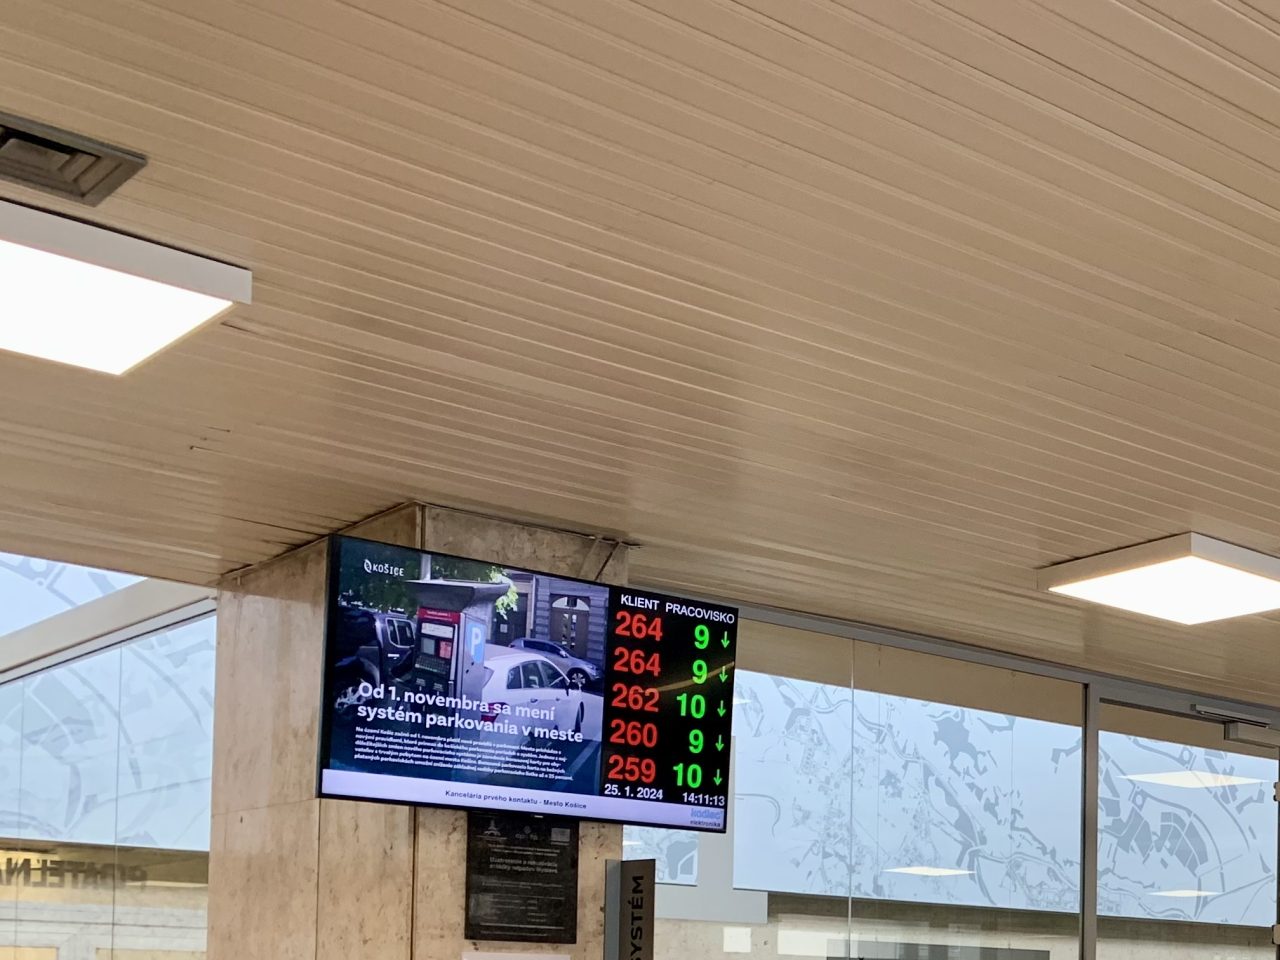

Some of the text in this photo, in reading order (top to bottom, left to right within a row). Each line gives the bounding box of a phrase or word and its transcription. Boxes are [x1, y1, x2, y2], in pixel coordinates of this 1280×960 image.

[372, 563, 404, 577] KOŠICE
[620, 594, 735, 624] KLIENT PRACOVISKO
[615, 610, 710, 649] 264 9
[613, 646, 708, 684] 264 9
[358, 682, 555, 721] Od 1. novembra sa mení
[611, 683, 706, 719] 262 10
[357, 703, 584, 743] systém parkovania v meste
[609, 719, 704, 754] 260 9
[607, 754, 702, 788] 259 10
[445, 790, 482, 800] Kancelária
[483, 794, 507, 803] prvého
[508, 797, 538, 805] kontaktu
[543, 799, 564, 807] Mesto
[564, 801, 587, 809] Košice
[604, 783, 725, 806] 25. 1. 2024 14:11:13
